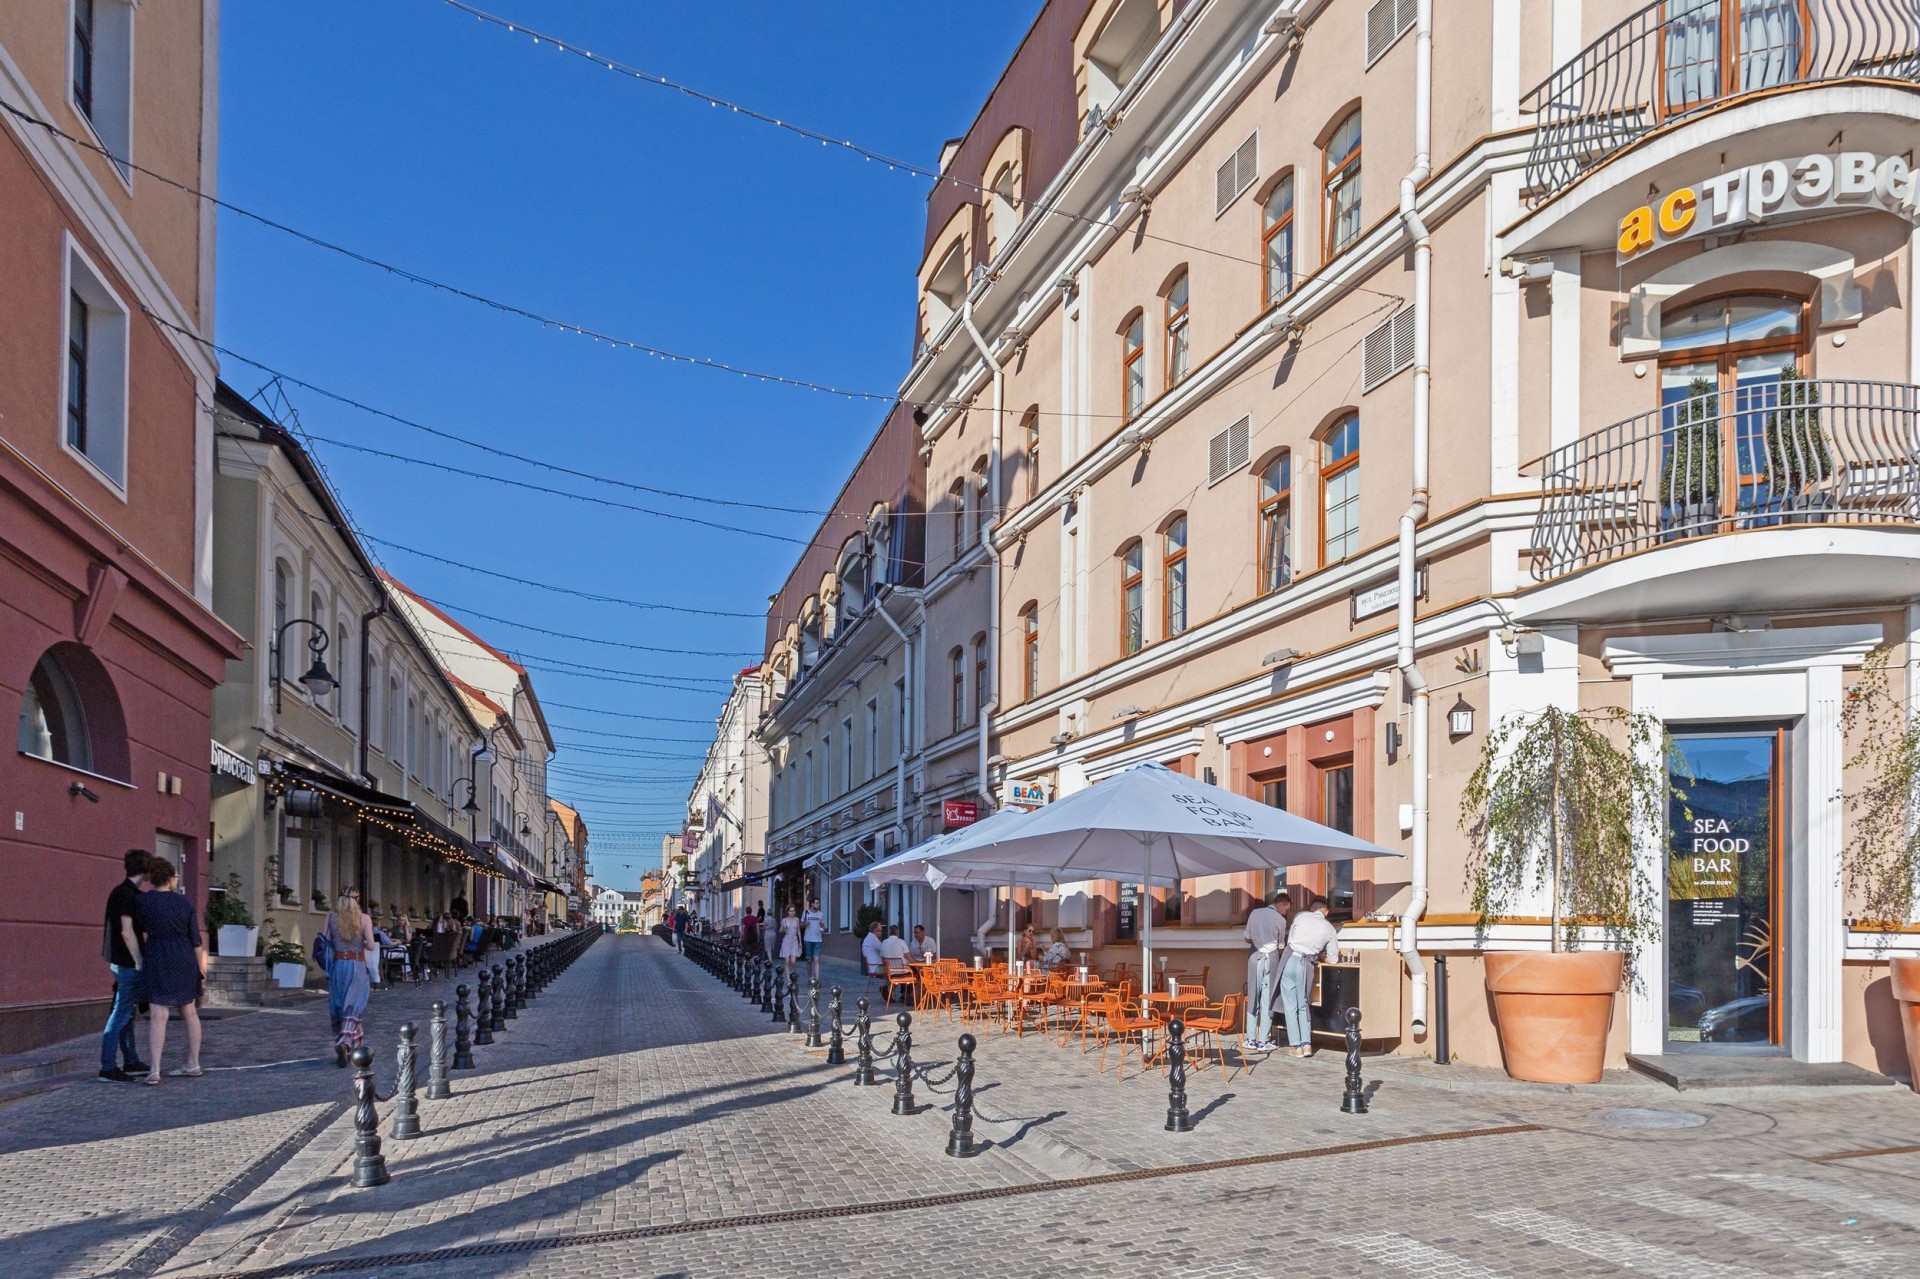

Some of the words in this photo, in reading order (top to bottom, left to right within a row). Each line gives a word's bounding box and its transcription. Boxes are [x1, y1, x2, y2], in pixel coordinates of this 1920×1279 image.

[1617, 151, 1919, 256] астрэве
[1456, 712, 1469, 730] 17
[210, 740, 256, 785] Брюссель
[259, 761, 270, 773] 32
[1171, 793, 1218, 807] SEA
[1186, 805, 1252, 821] FOOD
[1202, 816, 1254, 830] BAR
[1693, 819, 1730, 834] SEA
[1693, 838, 1749, 853] FOOD
[1693, 858, 1732, 873] BAR
